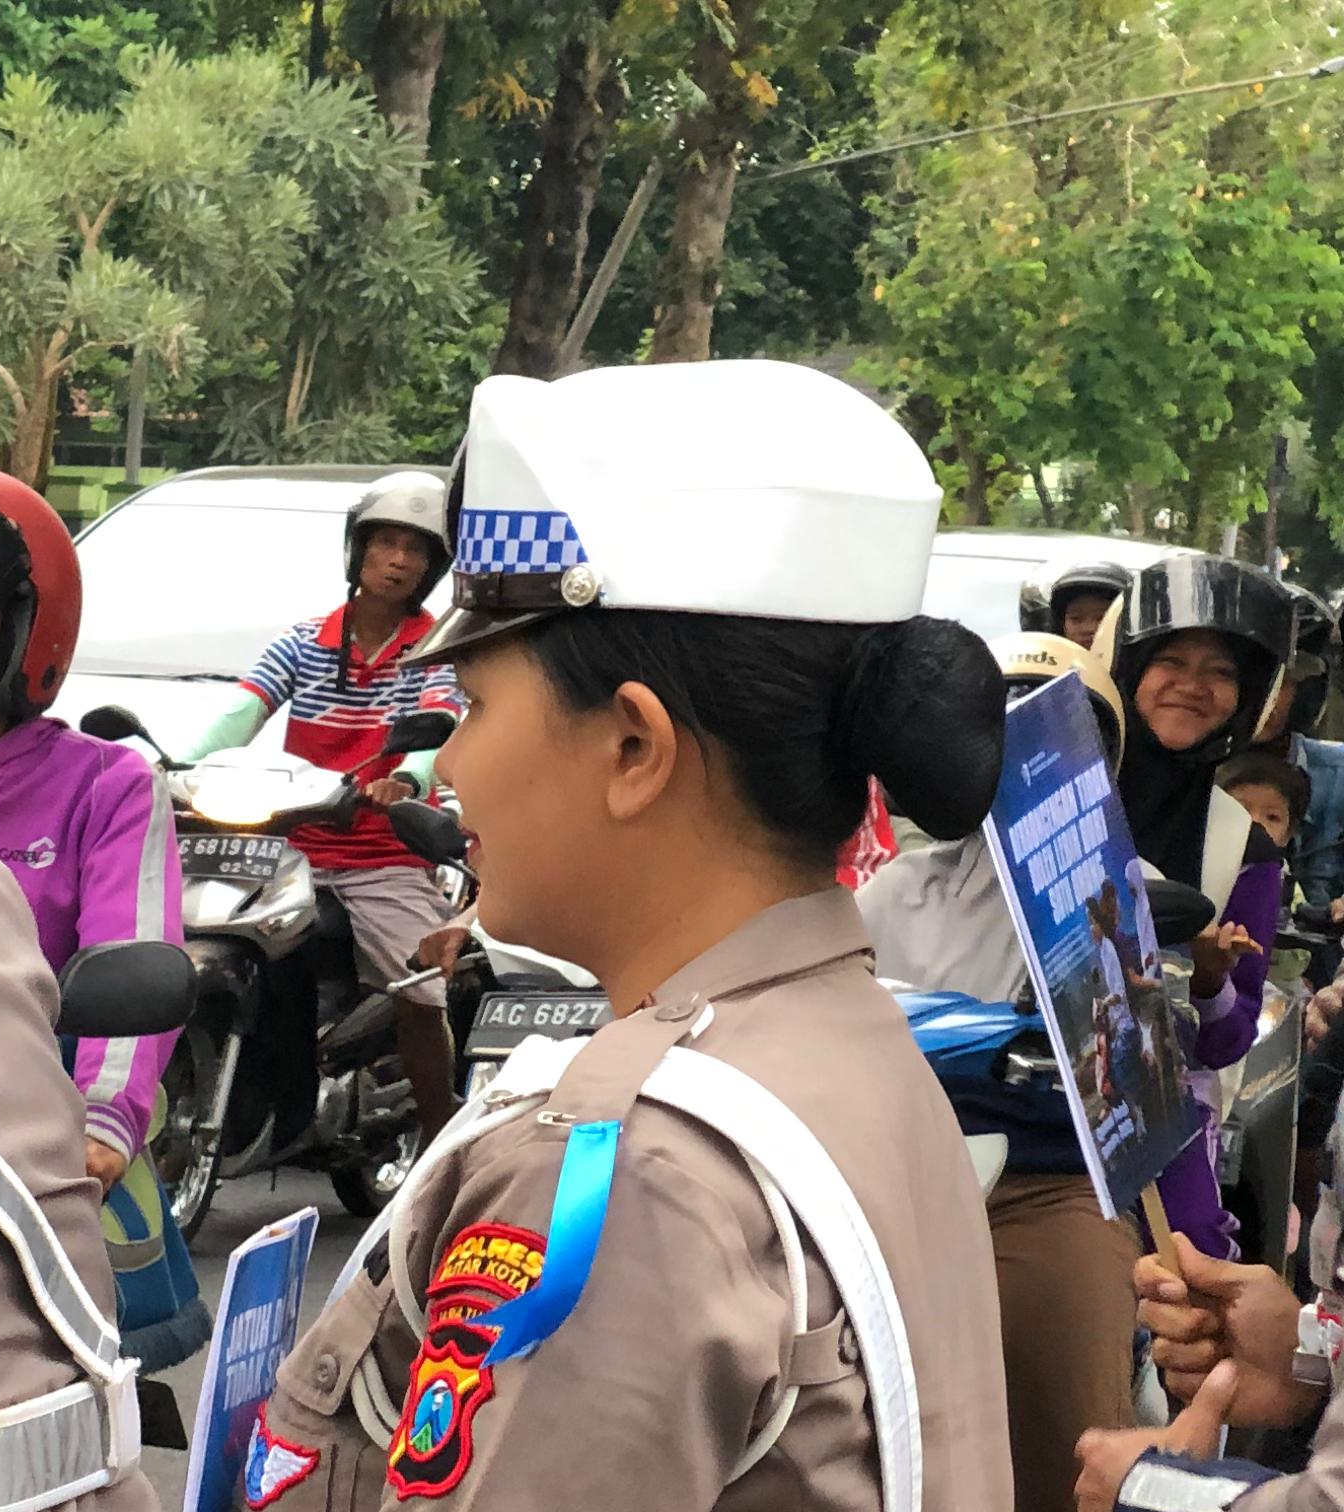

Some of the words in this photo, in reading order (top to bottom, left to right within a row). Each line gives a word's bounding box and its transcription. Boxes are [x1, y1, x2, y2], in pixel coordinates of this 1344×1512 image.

[193, 837, 243, 857] 6819
[487, 1002, 527, 1027] AG
[532, 1002, 607, 1026] 6827
[483, 1259, 530, 1296] KOTA
